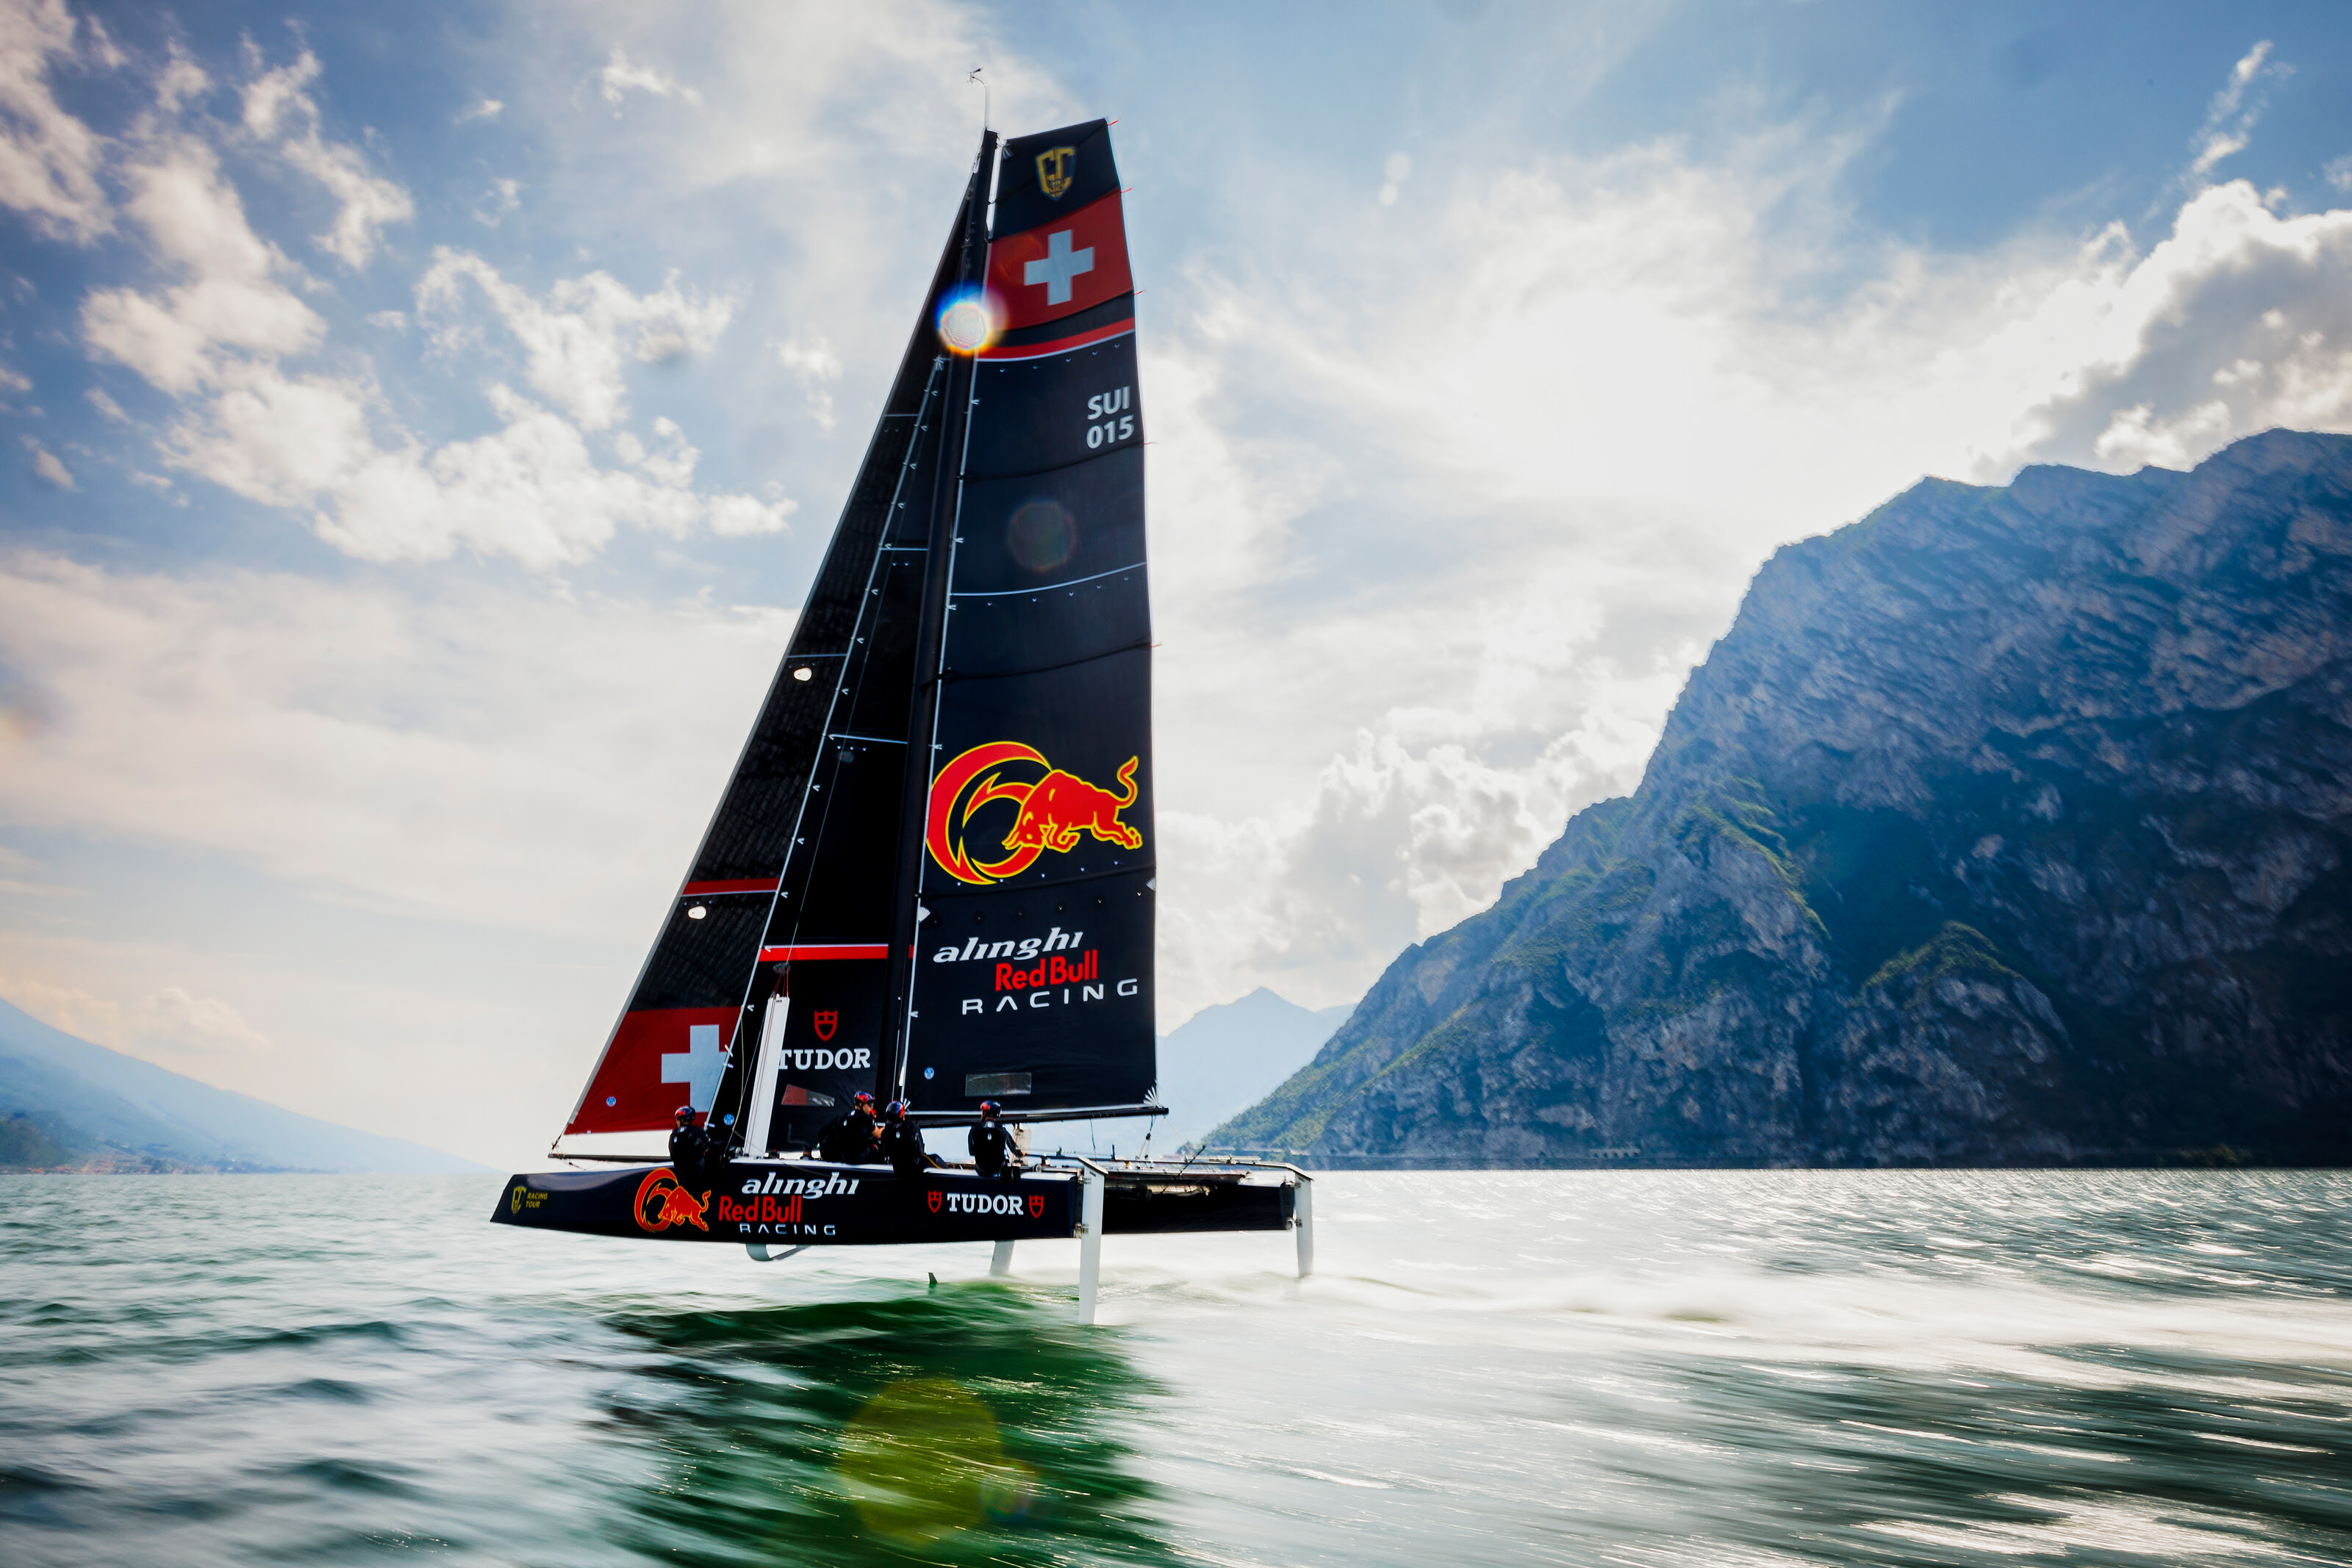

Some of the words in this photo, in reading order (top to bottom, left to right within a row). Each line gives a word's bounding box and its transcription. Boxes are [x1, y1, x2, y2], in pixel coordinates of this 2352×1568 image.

[1087, 386, 1130, 420] SUI
[1086, 414, 1134, 449] 015
[995, 958, 1046, 991] Red
[1050, 949, 1098, 985] Bull
[961, 978, 1139, 1015] RACING
[526, 1201, 541, 1209] TOUR
[718, 1195, 760, 1222] Red
[761, 1195, 803, 1223] Bull
[947, 1193, 1024, 1215] TUDOR
[739, 1223, 836, 1235] RACING
